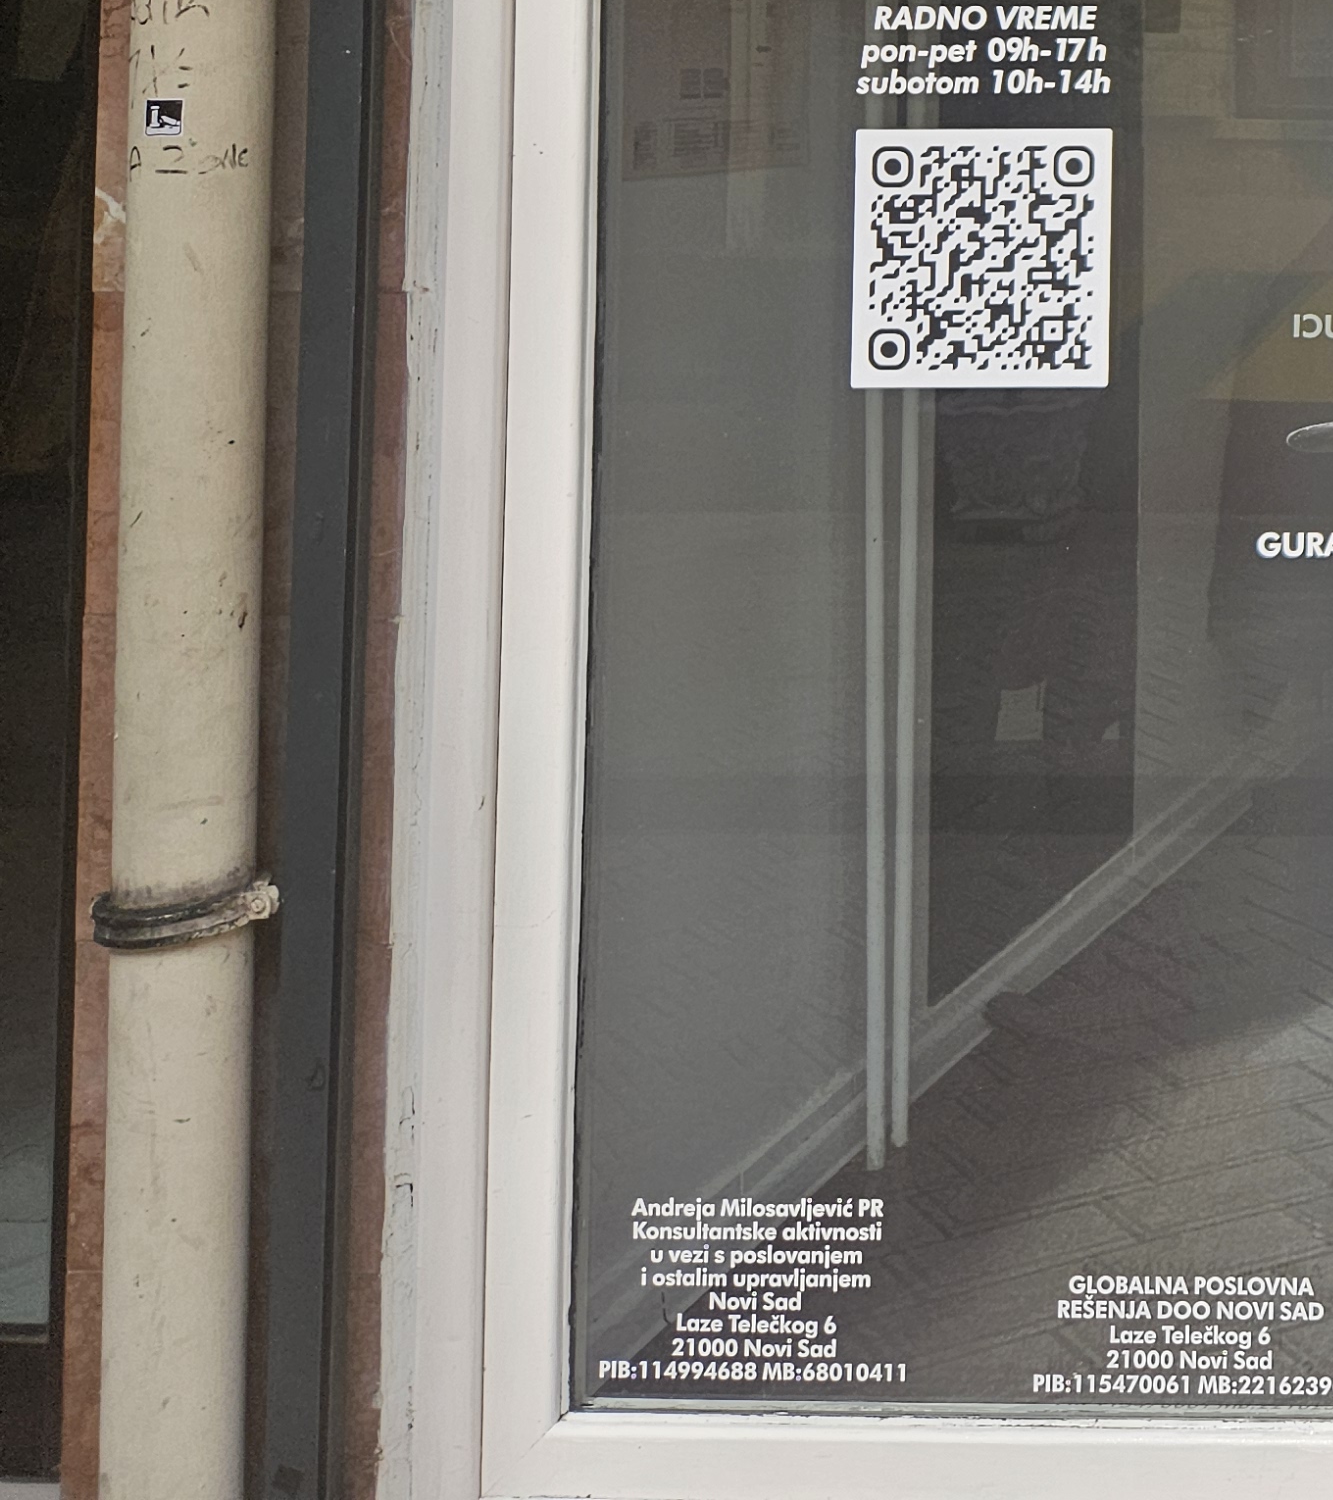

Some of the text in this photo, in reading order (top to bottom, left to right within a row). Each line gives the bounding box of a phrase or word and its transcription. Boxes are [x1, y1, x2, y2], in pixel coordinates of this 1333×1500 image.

[873, 5, 1098, 31] RADNO VREME
[860, 35, 1107, 69] pon-pet 09h-17h
[855, 68, 1111, 95] subotom 10h-14h
[631, 1196, 884, 1223] Andreja Milosavljević PR
[632, 1220, 882, 1241] Konsultantske aktivnosti
[650, 1243, 863, 1269] u vezi s poslovanjem
[640, 1266, 871, 1292] i ostalim upravljanjem
[1068, 1275, 1315, 1296] GLOBALNA POSLOVNA
[708, 1291, 802, 1311] Novi Sad
[1056, 1295, 1325, 1321] REŠENJA DOO NOVI SAD
[676, 1312, 837, 1338] Laze Telečkog 6
[1109, 1324, 1271, 1350] Laze Telečkog 6
[671, 1337, 837, 1358] 21000 Novi Sad
[1106, 1349, 1273, 1370] 21000 Novi Sad
[598, 1360, 906, 1382] PIB:114994688 MB:68010411
[1032, 1372, 1190, 1394] PIB:115470061
